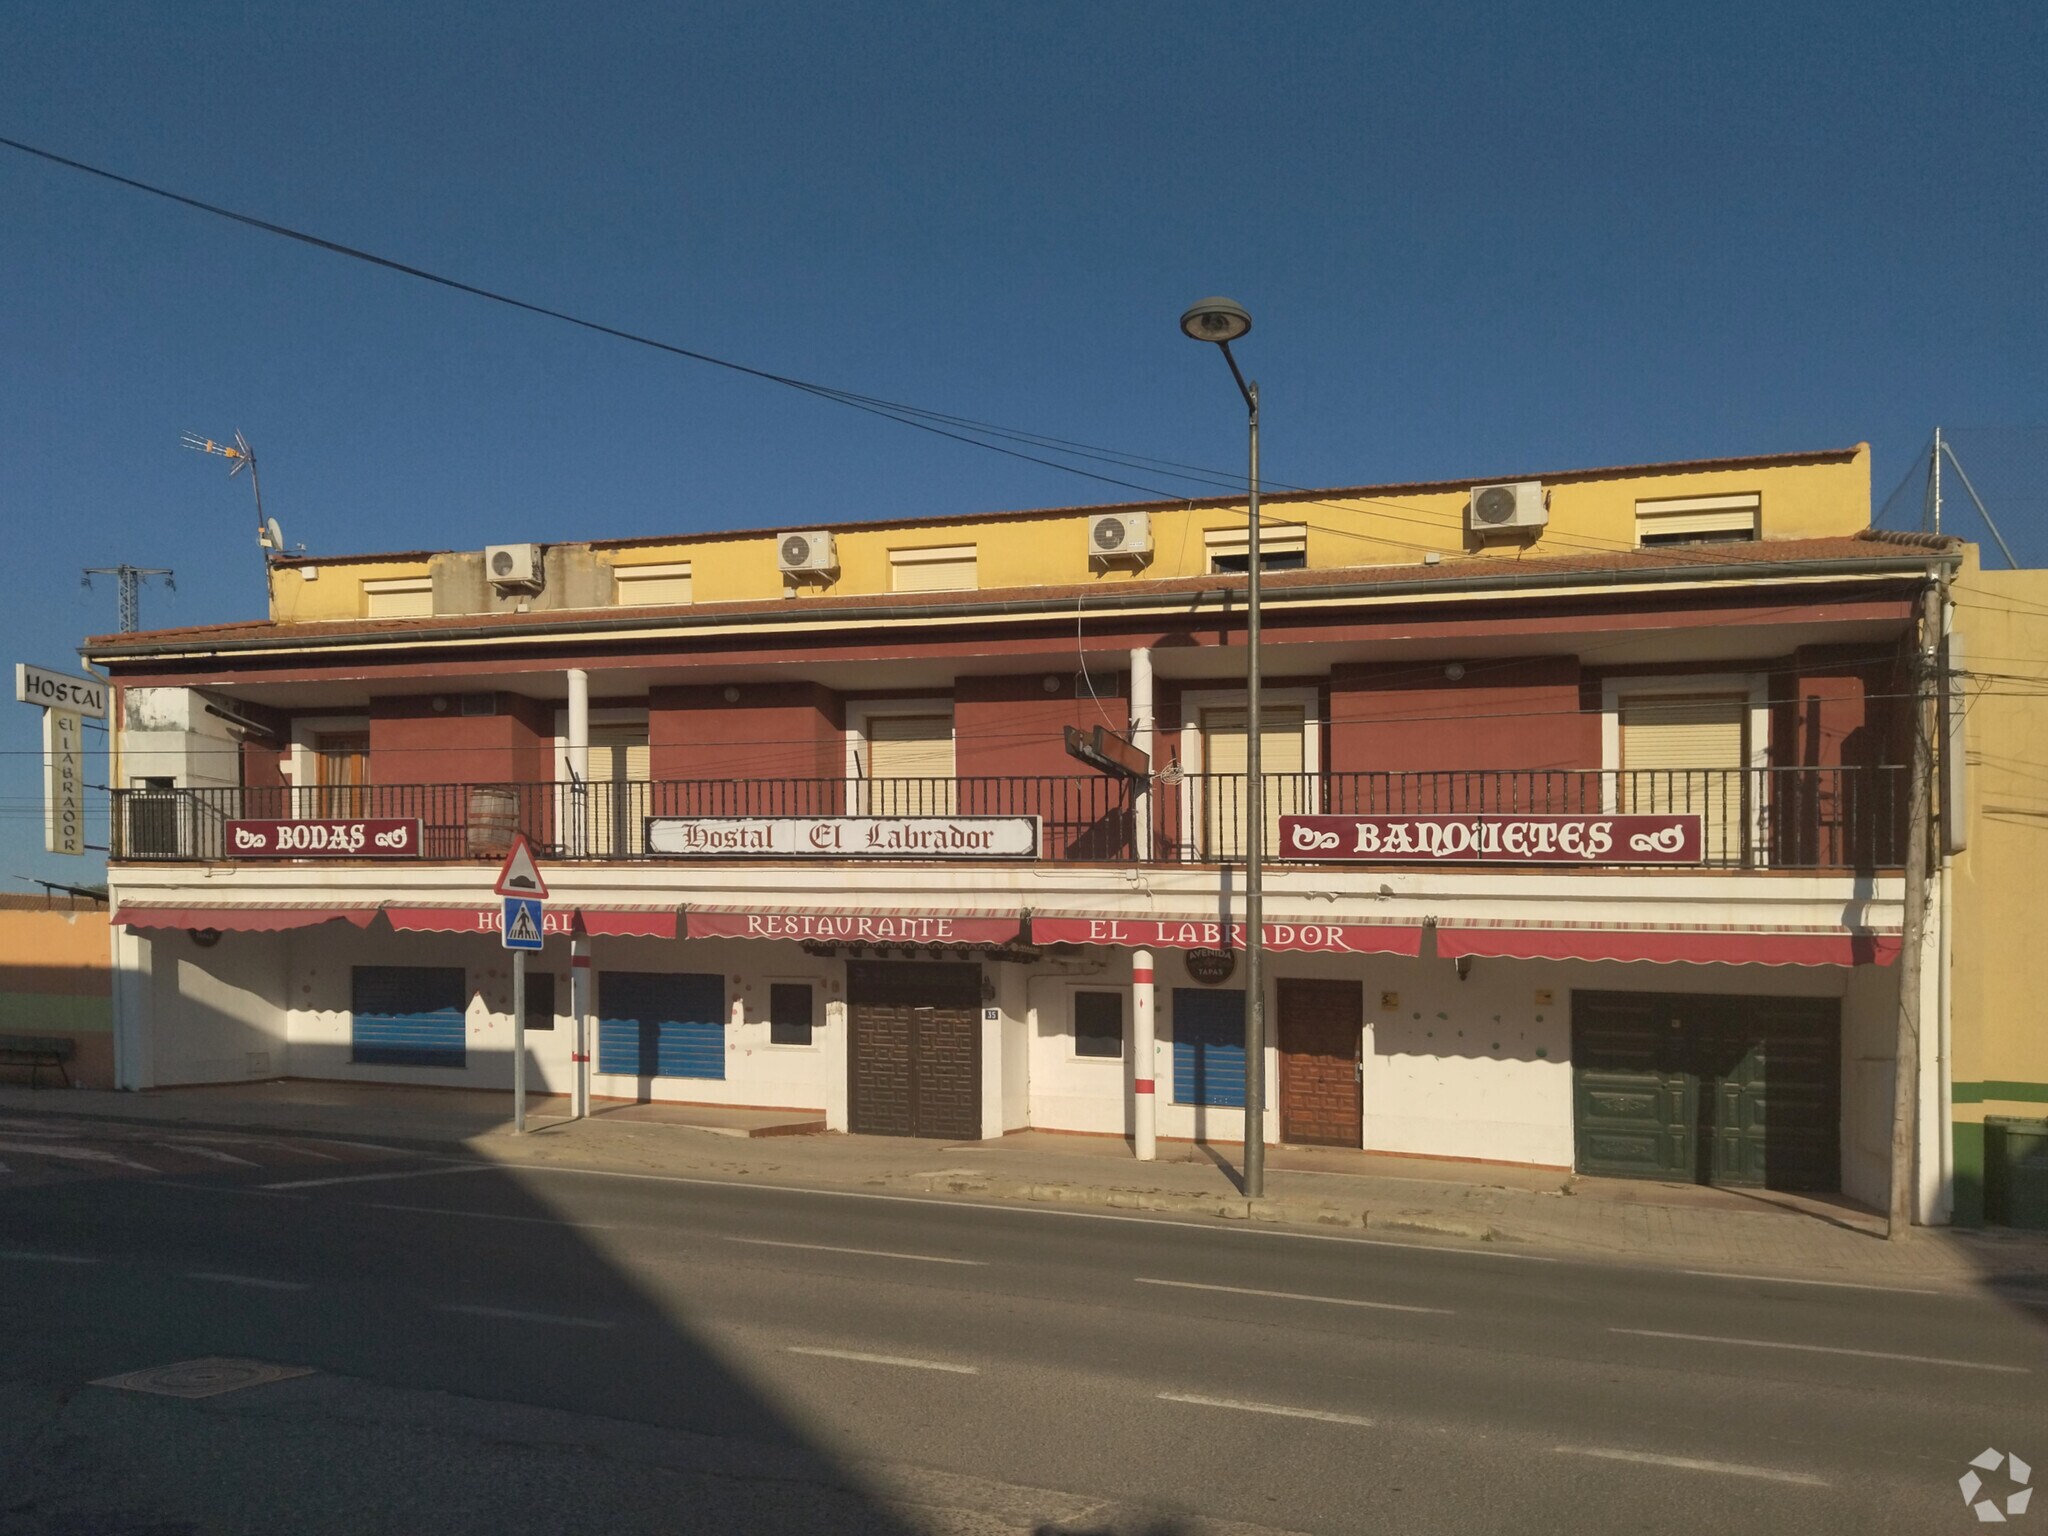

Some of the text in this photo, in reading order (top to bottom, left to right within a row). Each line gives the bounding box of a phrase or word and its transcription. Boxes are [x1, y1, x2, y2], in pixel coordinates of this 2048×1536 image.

[26, 674, 103, 709] HOSTAL
[275, 824, 365, 853] BODAS
[682, 823, 995, 852] Hostal El Labrador
[1353, 821, 1613, 858] BANQUETES
[478, 911, 573, 932] HAL
[747, 914, 953, 939] RESTAURANTE
[1089, 919, 1128, 940] EL
